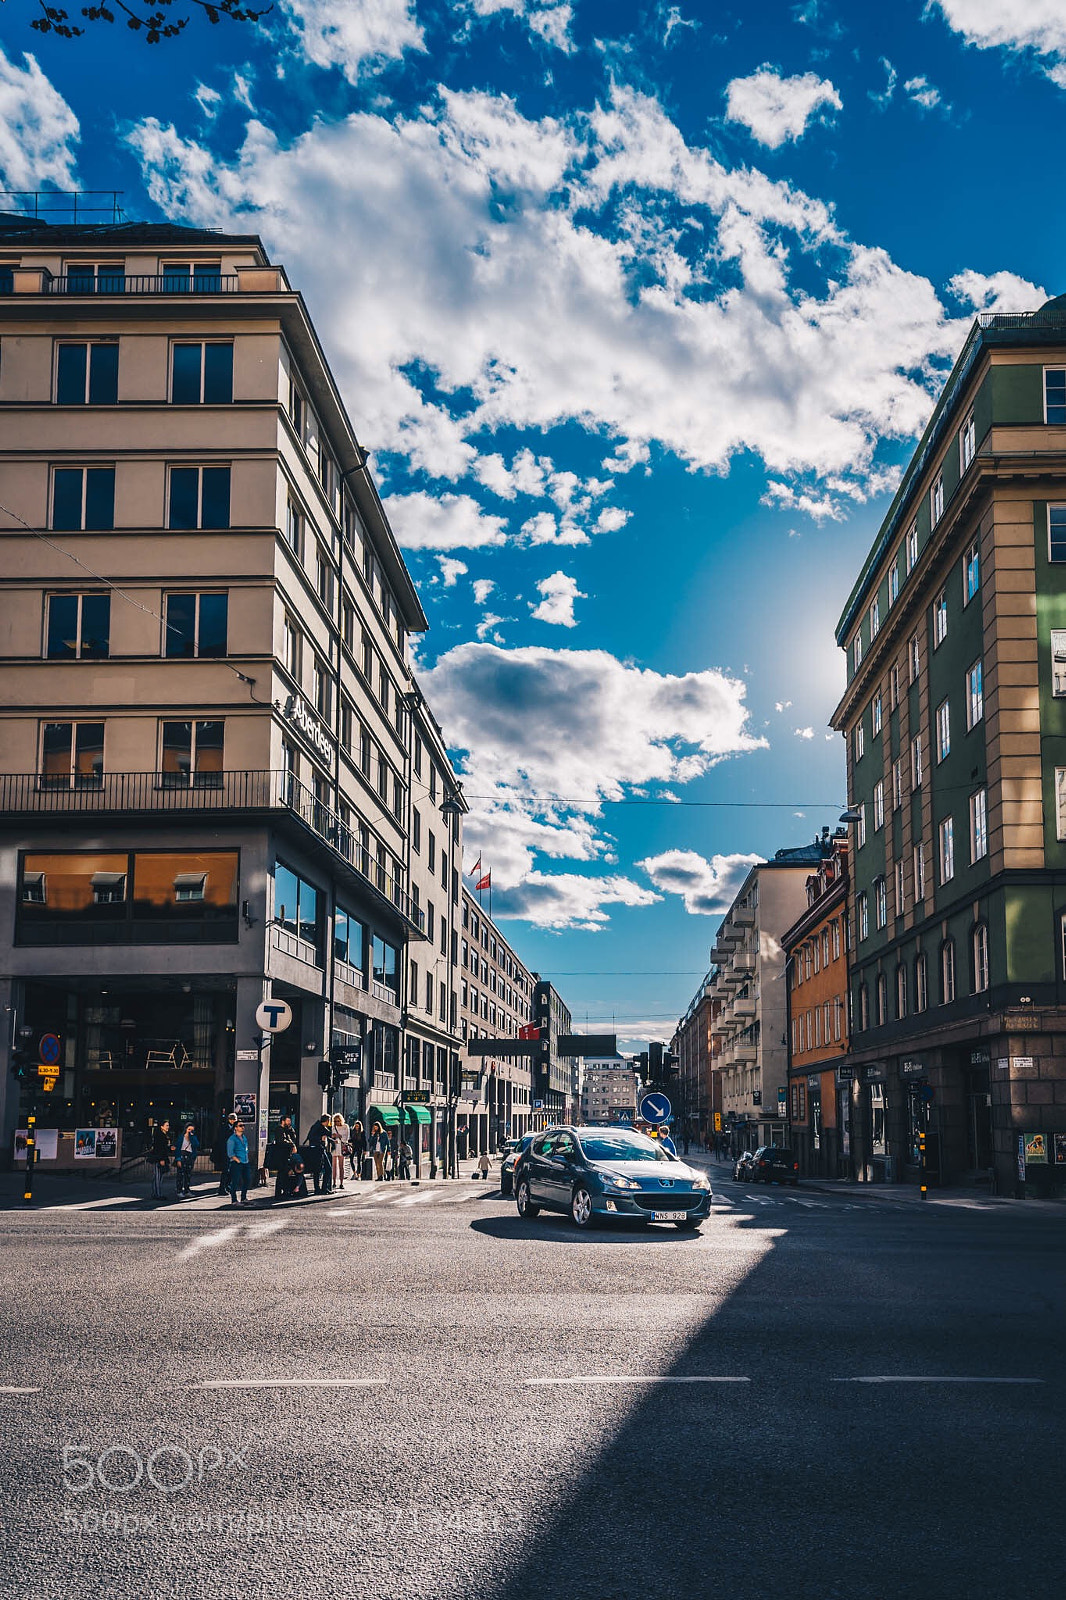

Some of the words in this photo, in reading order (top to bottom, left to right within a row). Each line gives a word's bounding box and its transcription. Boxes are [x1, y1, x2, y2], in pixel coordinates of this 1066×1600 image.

[290, 694, 333, 764] Aberdeen
[264, 1005, 286, 1028] T
[655, 1212, 668, 1220] WNS
